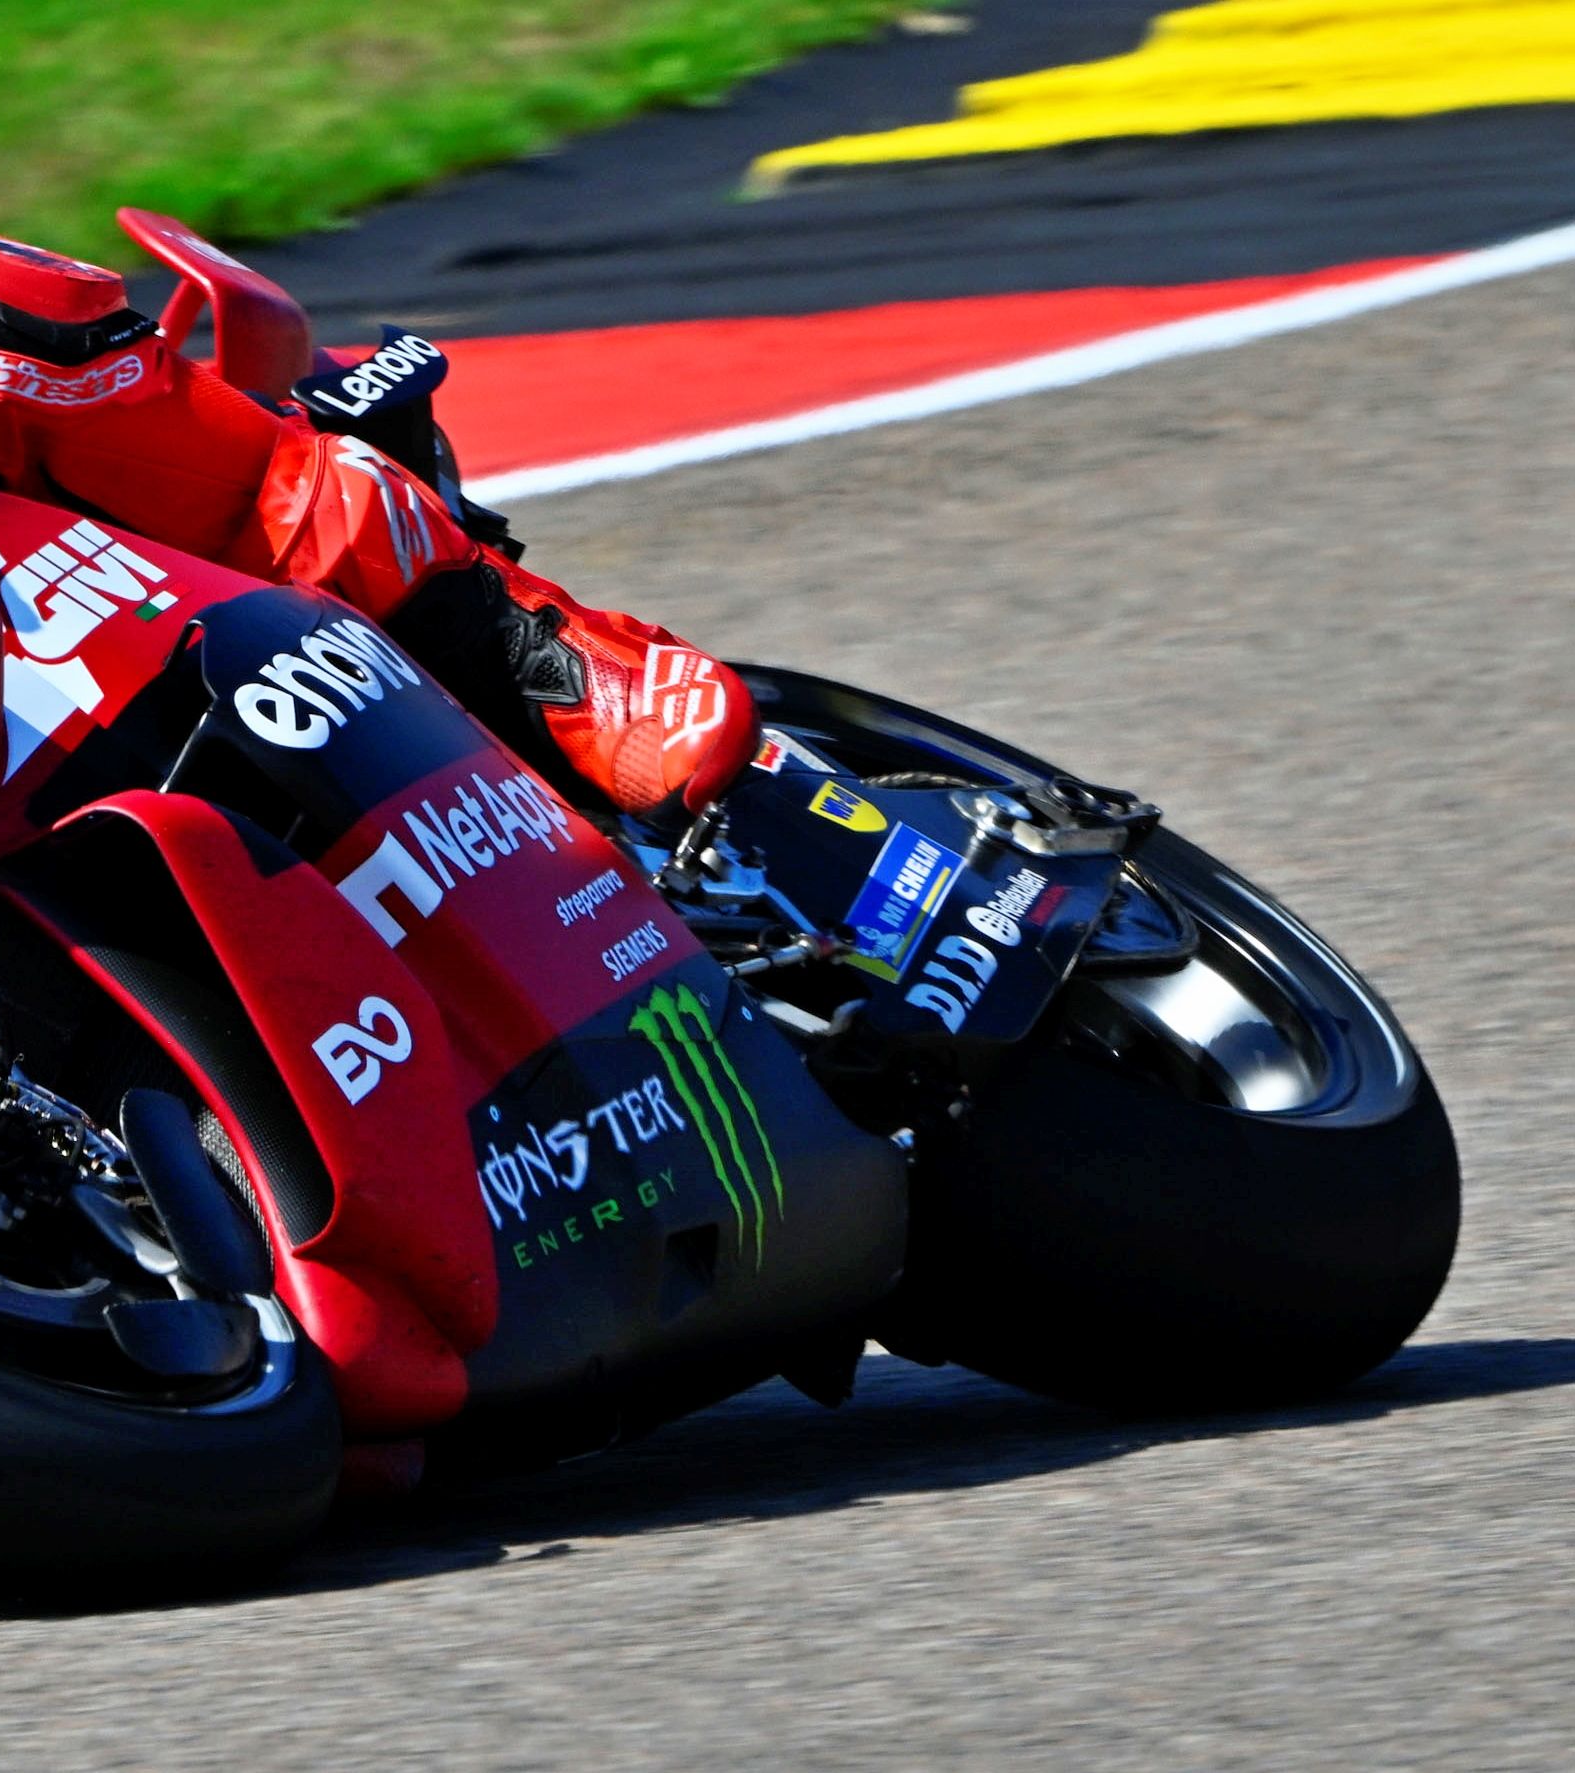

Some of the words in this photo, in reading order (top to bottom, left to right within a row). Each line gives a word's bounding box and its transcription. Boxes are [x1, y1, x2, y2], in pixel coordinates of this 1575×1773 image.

[312, 334, 442, 418] Lenovo
[8, 518, 169, 661] GIVI
[402, 772, 574, 890] NetApp
[555, 868, 626, 927] streparava
[878, 838, 943, 929] MICHELIN
[601, 920, 669, 982] SIEMENS
[513, 1167, 676, 1269] ENERGY
